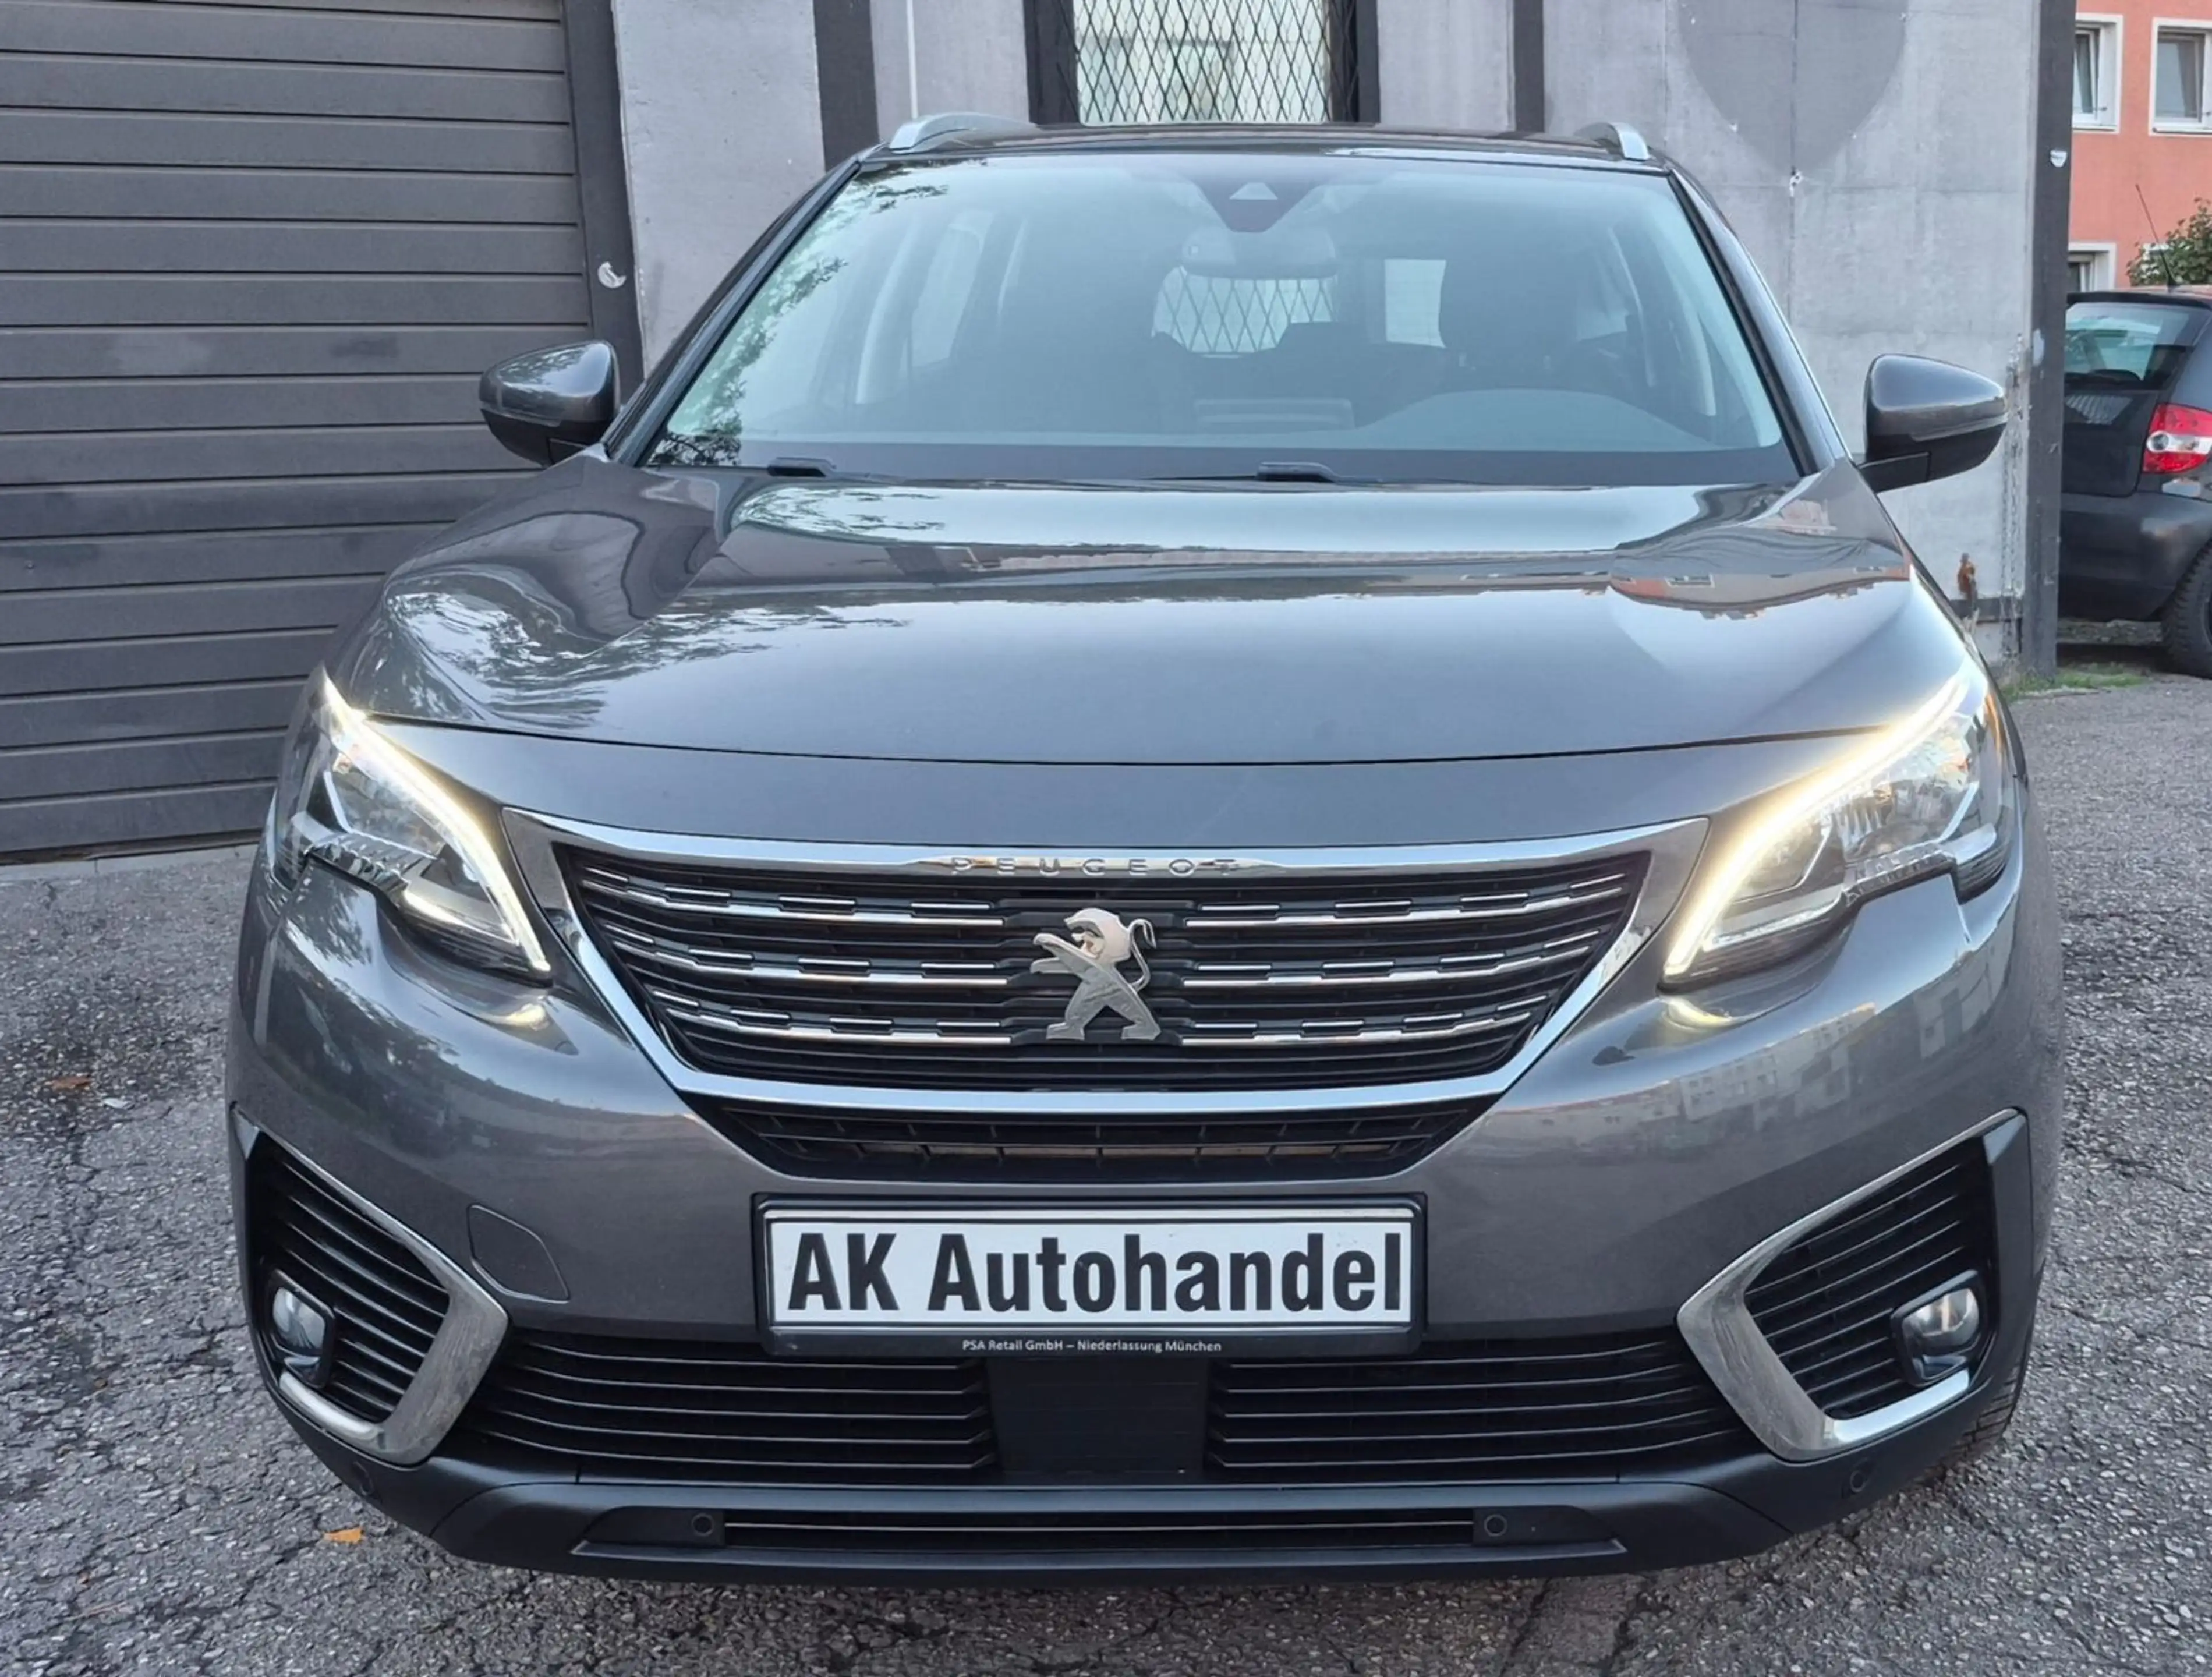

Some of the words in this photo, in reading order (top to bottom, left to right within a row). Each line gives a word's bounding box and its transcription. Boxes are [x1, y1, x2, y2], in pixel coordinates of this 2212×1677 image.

[950, 857, 1239, 876] PEUGEOT
[788, 1232, 898, 1311] AK
[927, 1232, 1402, 1311] Autohandel
[962, 1339, 986, 1350] PSA
[988, 1339, 1022, 1350] Retail
[1025, 1340, 1063, 1351] GmbH
[1077, 1340, 1162, 1353] Niederlassung
[1165, 1340, 1222, 1351] München
